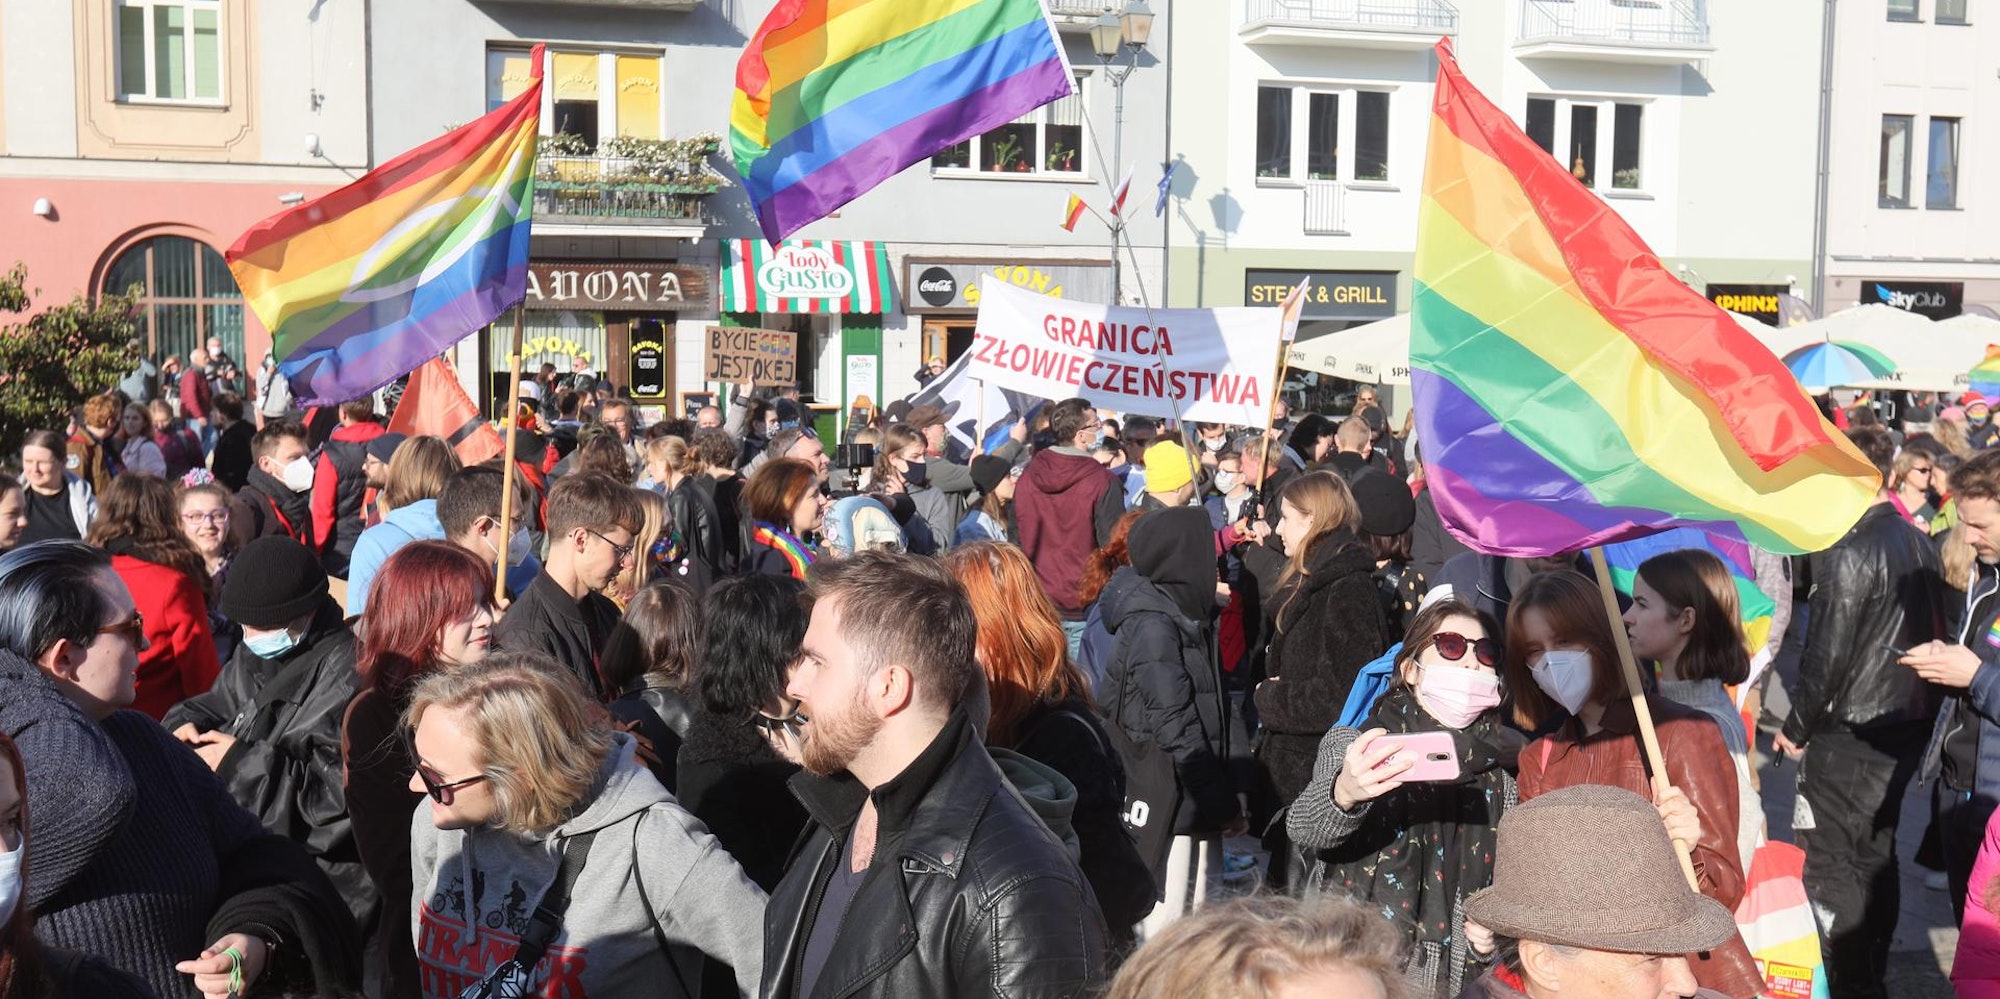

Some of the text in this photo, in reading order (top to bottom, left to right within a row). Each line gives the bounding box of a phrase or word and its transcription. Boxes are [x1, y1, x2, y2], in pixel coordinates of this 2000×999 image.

[525, 269, 685, 303] AVONA
[961, 264, 1064, 308] SVONA
[1316, 285, 1330, 304] &
[1333, 286, 1388, 304] GRILL
[1714, 294, 1779, 314] SPHINX
[1043, 313, 1174, 356] GRANICA
[974, 332, 1261, 407] ZŁOWIECZEŃSTWA
